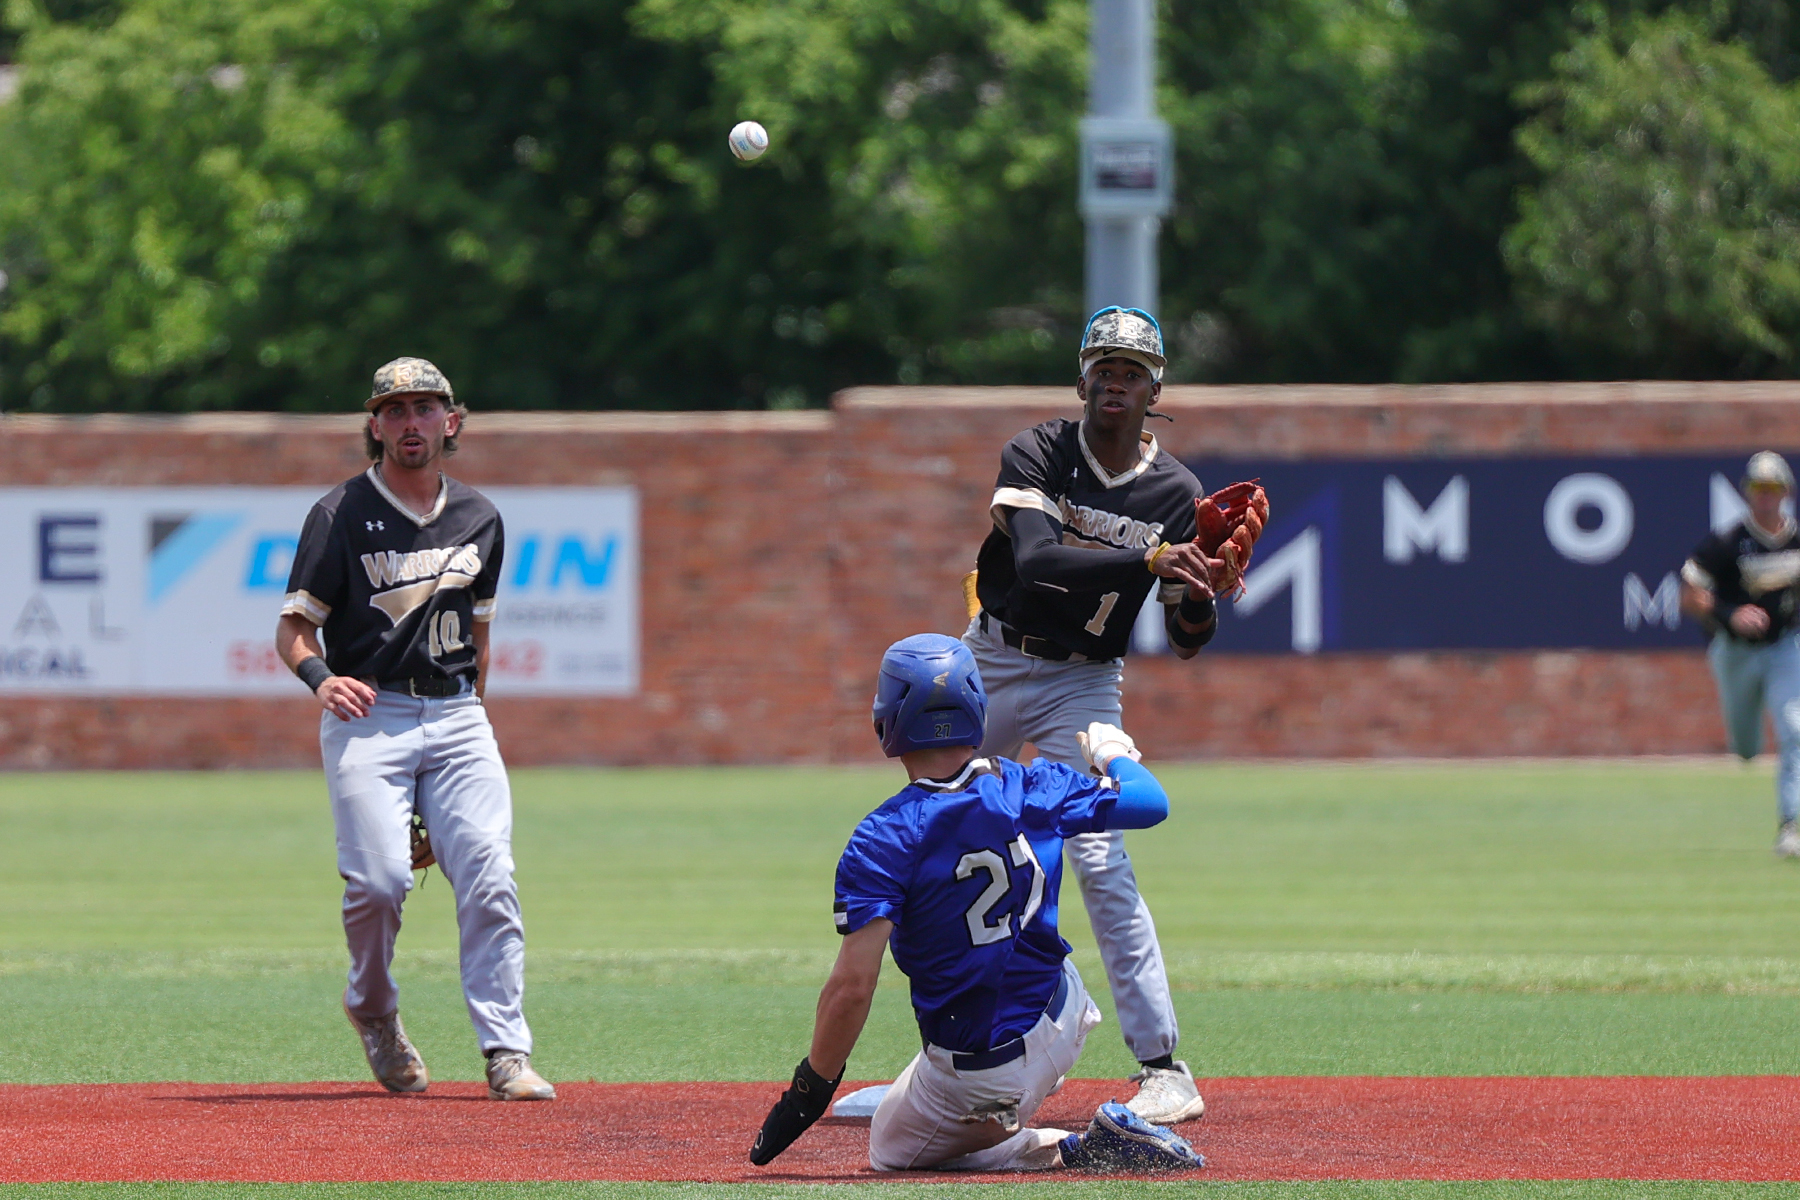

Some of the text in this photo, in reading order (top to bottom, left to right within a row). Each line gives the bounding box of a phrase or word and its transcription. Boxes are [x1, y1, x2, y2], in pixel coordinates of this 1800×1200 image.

[428, 610, 464, 657] 10
[1084, 591, 1119, 636] 1
[934, 723, 952, 739] 27
[955, 832, 1046, 947] 27
